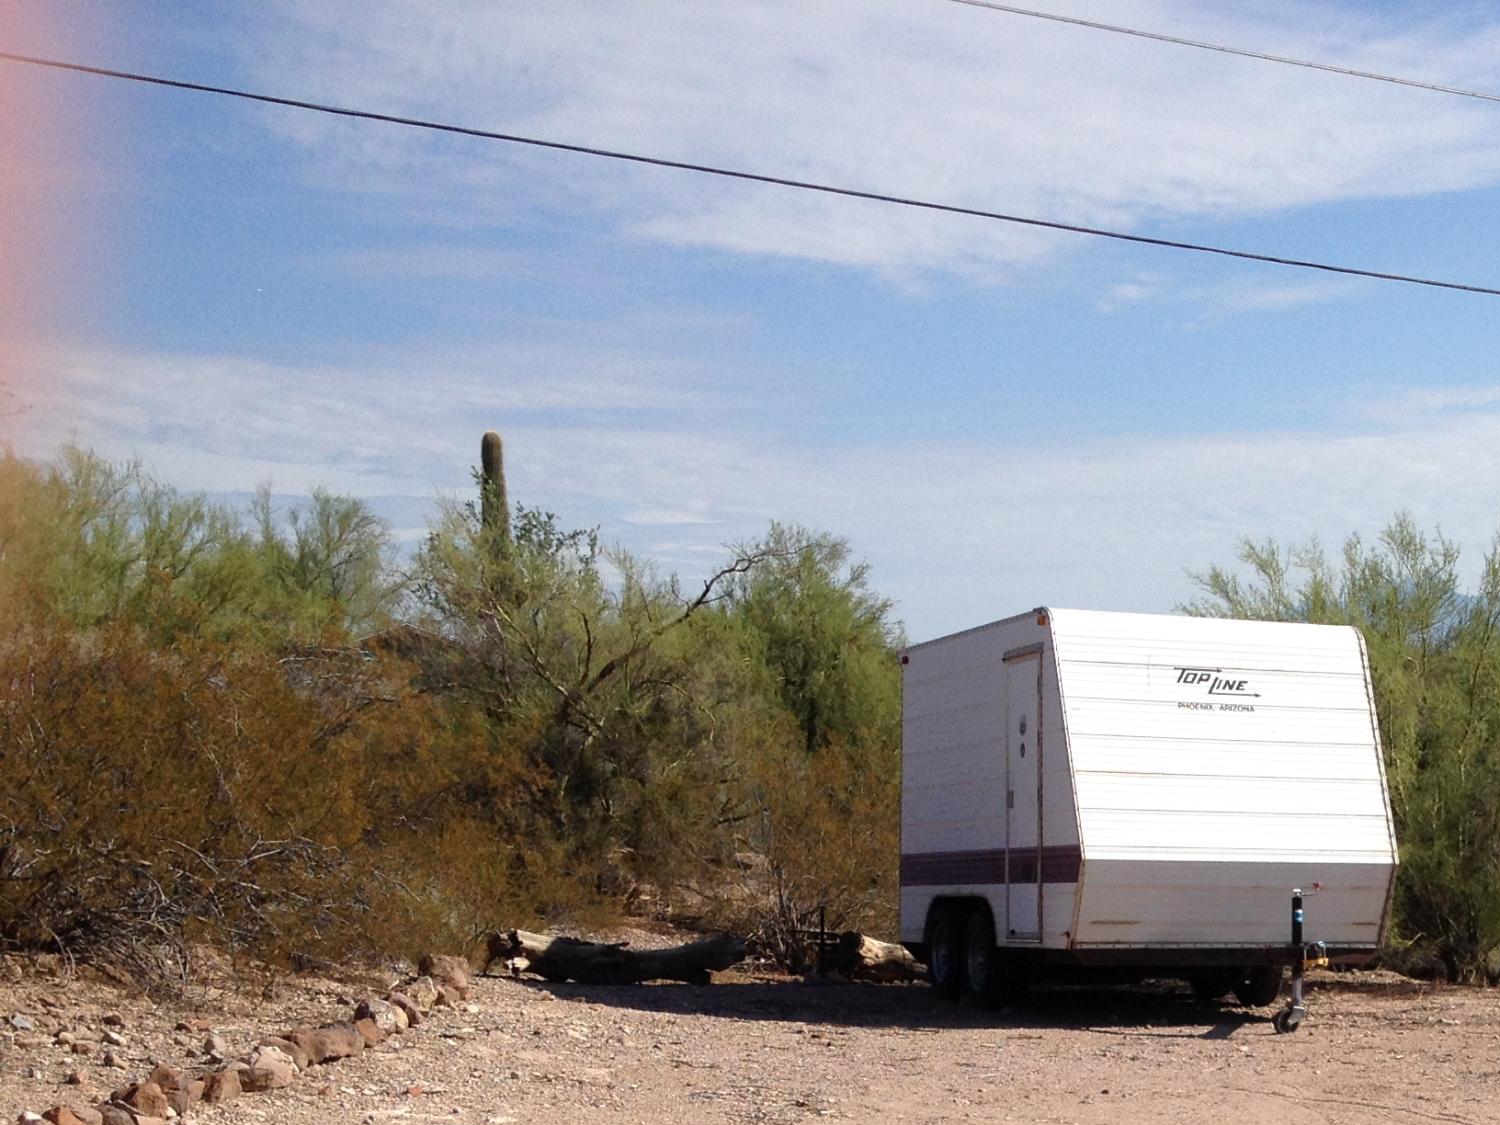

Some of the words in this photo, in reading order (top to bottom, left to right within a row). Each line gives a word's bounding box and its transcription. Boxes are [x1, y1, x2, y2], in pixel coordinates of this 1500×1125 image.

[1174, 667, 1221, 684] TOP
[1208, 677, 1260, 697] LINE
[1219, 704, 1255, 712] ARIZONA
